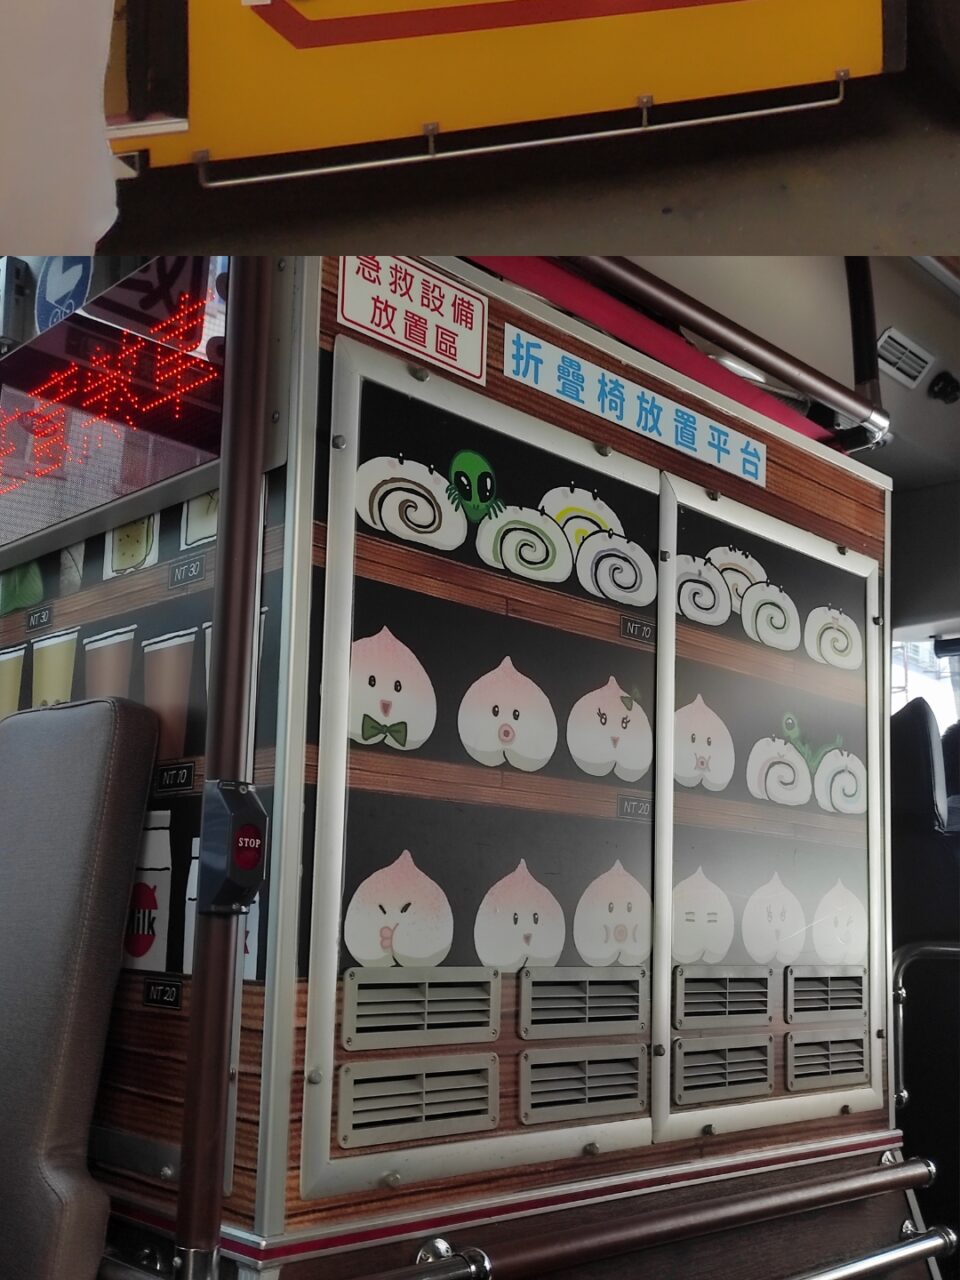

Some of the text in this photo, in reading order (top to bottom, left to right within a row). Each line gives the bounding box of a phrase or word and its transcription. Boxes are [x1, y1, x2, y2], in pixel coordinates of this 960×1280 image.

[356, 256, 475, 331] 急救設備
[370, 296, 459, 362] 放置區
[511, 333, 762, 482] 折疊椅放置平台
[174, 560, 200, 582] NT 30
[29, 609, 49, 626] NT 30
[626, 622, 651, 638] NT 10
[162, 769, 187, 785] NT 10
[623, 800, 650, 816] NT 20
[238, 837, 261, 848] STOP
[150, 985, 175, 1002] NT 20
